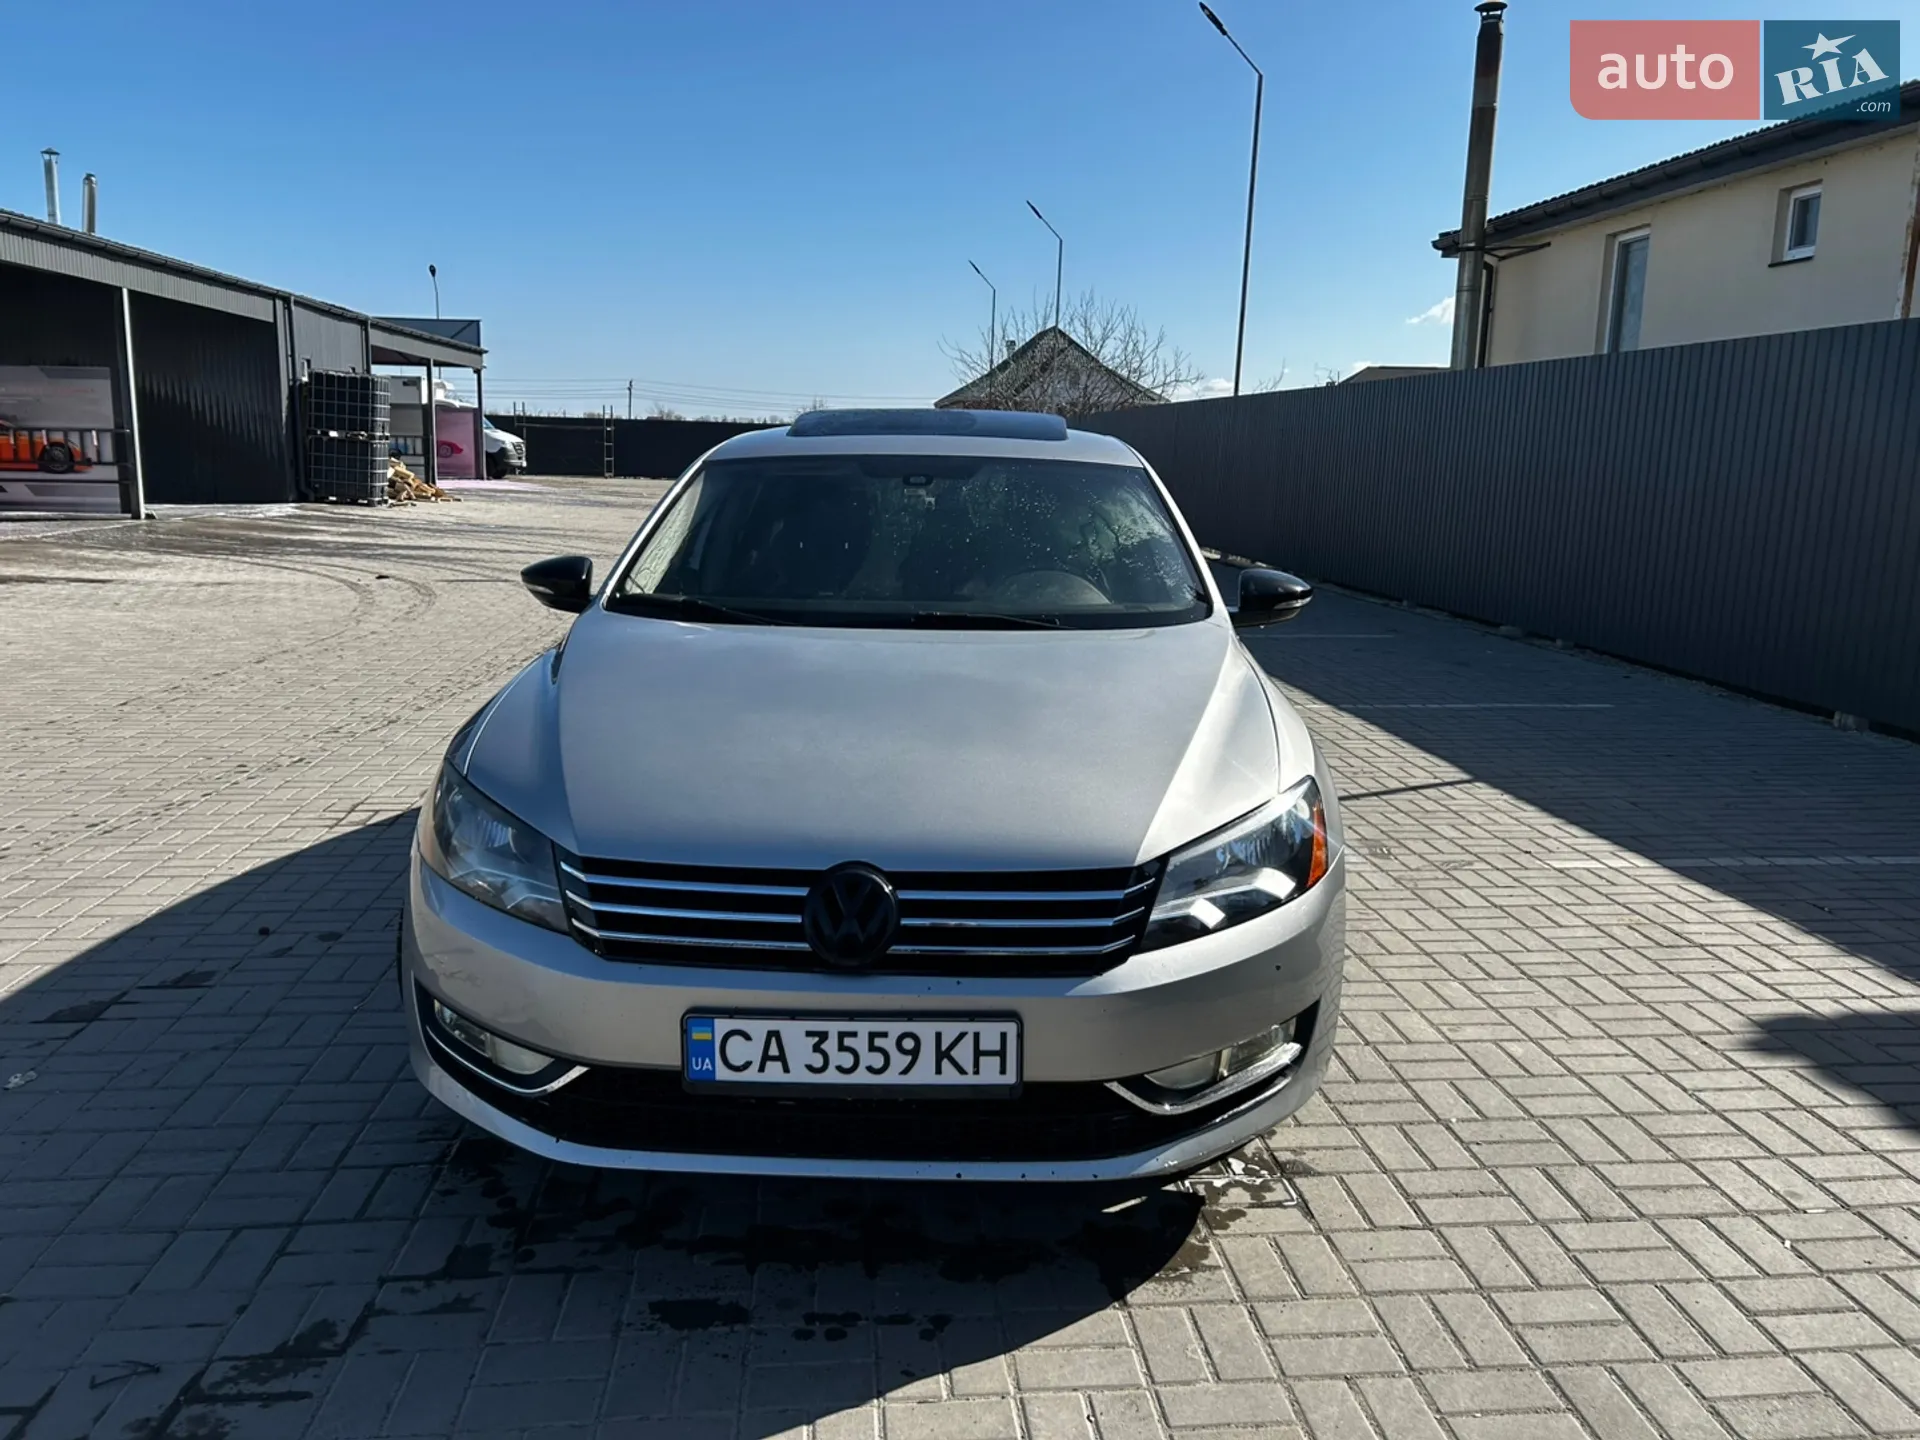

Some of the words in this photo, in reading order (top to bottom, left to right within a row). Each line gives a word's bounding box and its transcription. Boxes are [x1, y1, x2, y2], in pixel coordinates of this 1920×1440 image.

[691, 1057, 713, 1072] UA
[719, 1029, 791, 1074] CA
[804, 1030, 922, 1076] 3559
[934, 1031, 1008, 1076] KH
